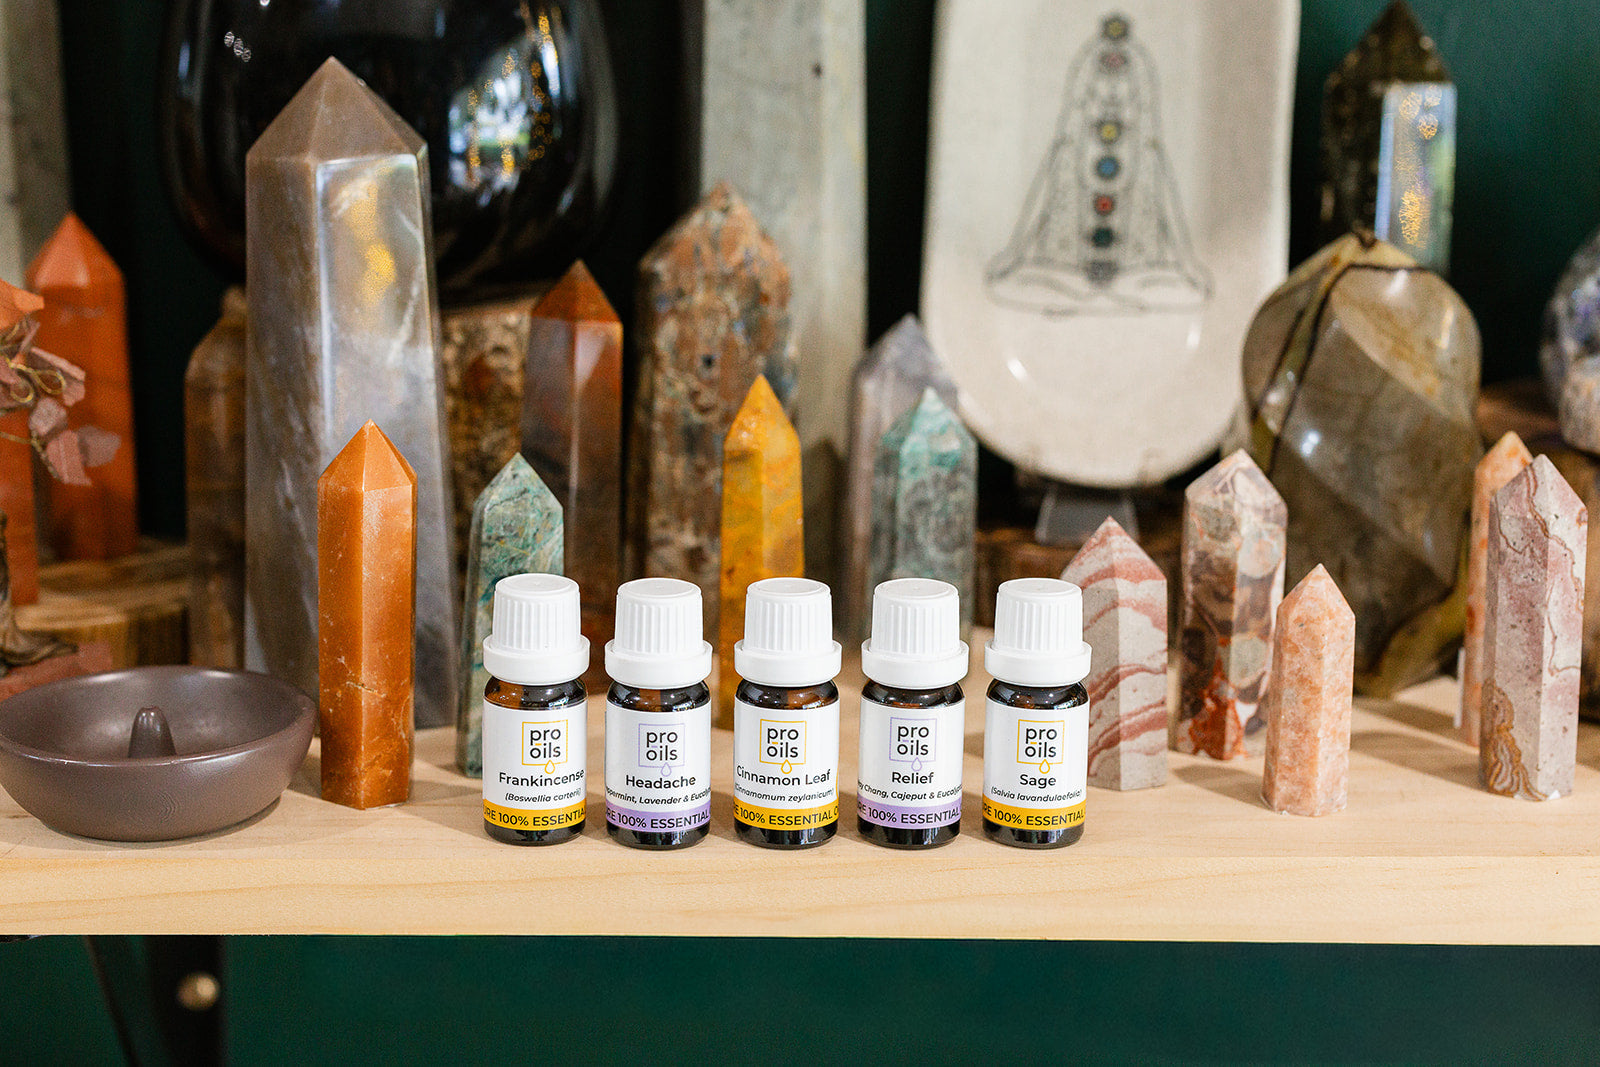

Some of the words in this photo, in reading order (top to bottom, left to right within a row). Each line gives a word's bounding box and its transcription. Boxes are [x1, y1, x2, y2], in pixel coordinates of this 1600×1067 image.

[530, 729, 561, 746] pro
[646, 731, 678, 748] pro
[767, 728, 799, 744] pro
[897, 725, 929, 742] pro
[1025, 728, 1058, 744] pro
[530, 742, 561, 759] oils
[646, 745, 678, 761] oils
[766, 742, 799, 758] oils
[896, 739, 929, 756] oils
[1025, 742, 1057, 758] oils
[499, 769, 585, 787] Frankincense
[625, 774, 696, 789] Headache
[736, 765, 800, 786] Cinnamon
[805, 769, 831, 785] Leaf
[891, 771, 935, 785] Relief
[1019, 774, 1057, 789] Sage
[505, 792, 552, 803] (Boswellia
[639, 797, 682, 805] Lavender
[683, 795, 689, 803] &
[864, 784, 889, 799] Chang,
[890, 791, 927, 801] Cajeput
[929, 791, 935, 799] &
[991, 786, 1015, 799] (Salvia
[498, 812, 529, 826] 100%
[617, 812, 647, 828] 100%
[650, 809, 709, 829] ESSENTIAL
[740, 807, 766, 824] 100%
[769, 809, 833, 826] ESSENTIAL
[868, 807, 897, 823] 100%
[901, 807, 960, 824] ESSENTIAL
[994, 808, 1023, 825] 100%
[1026, 809, 1085, 826] ESSENTIAL
